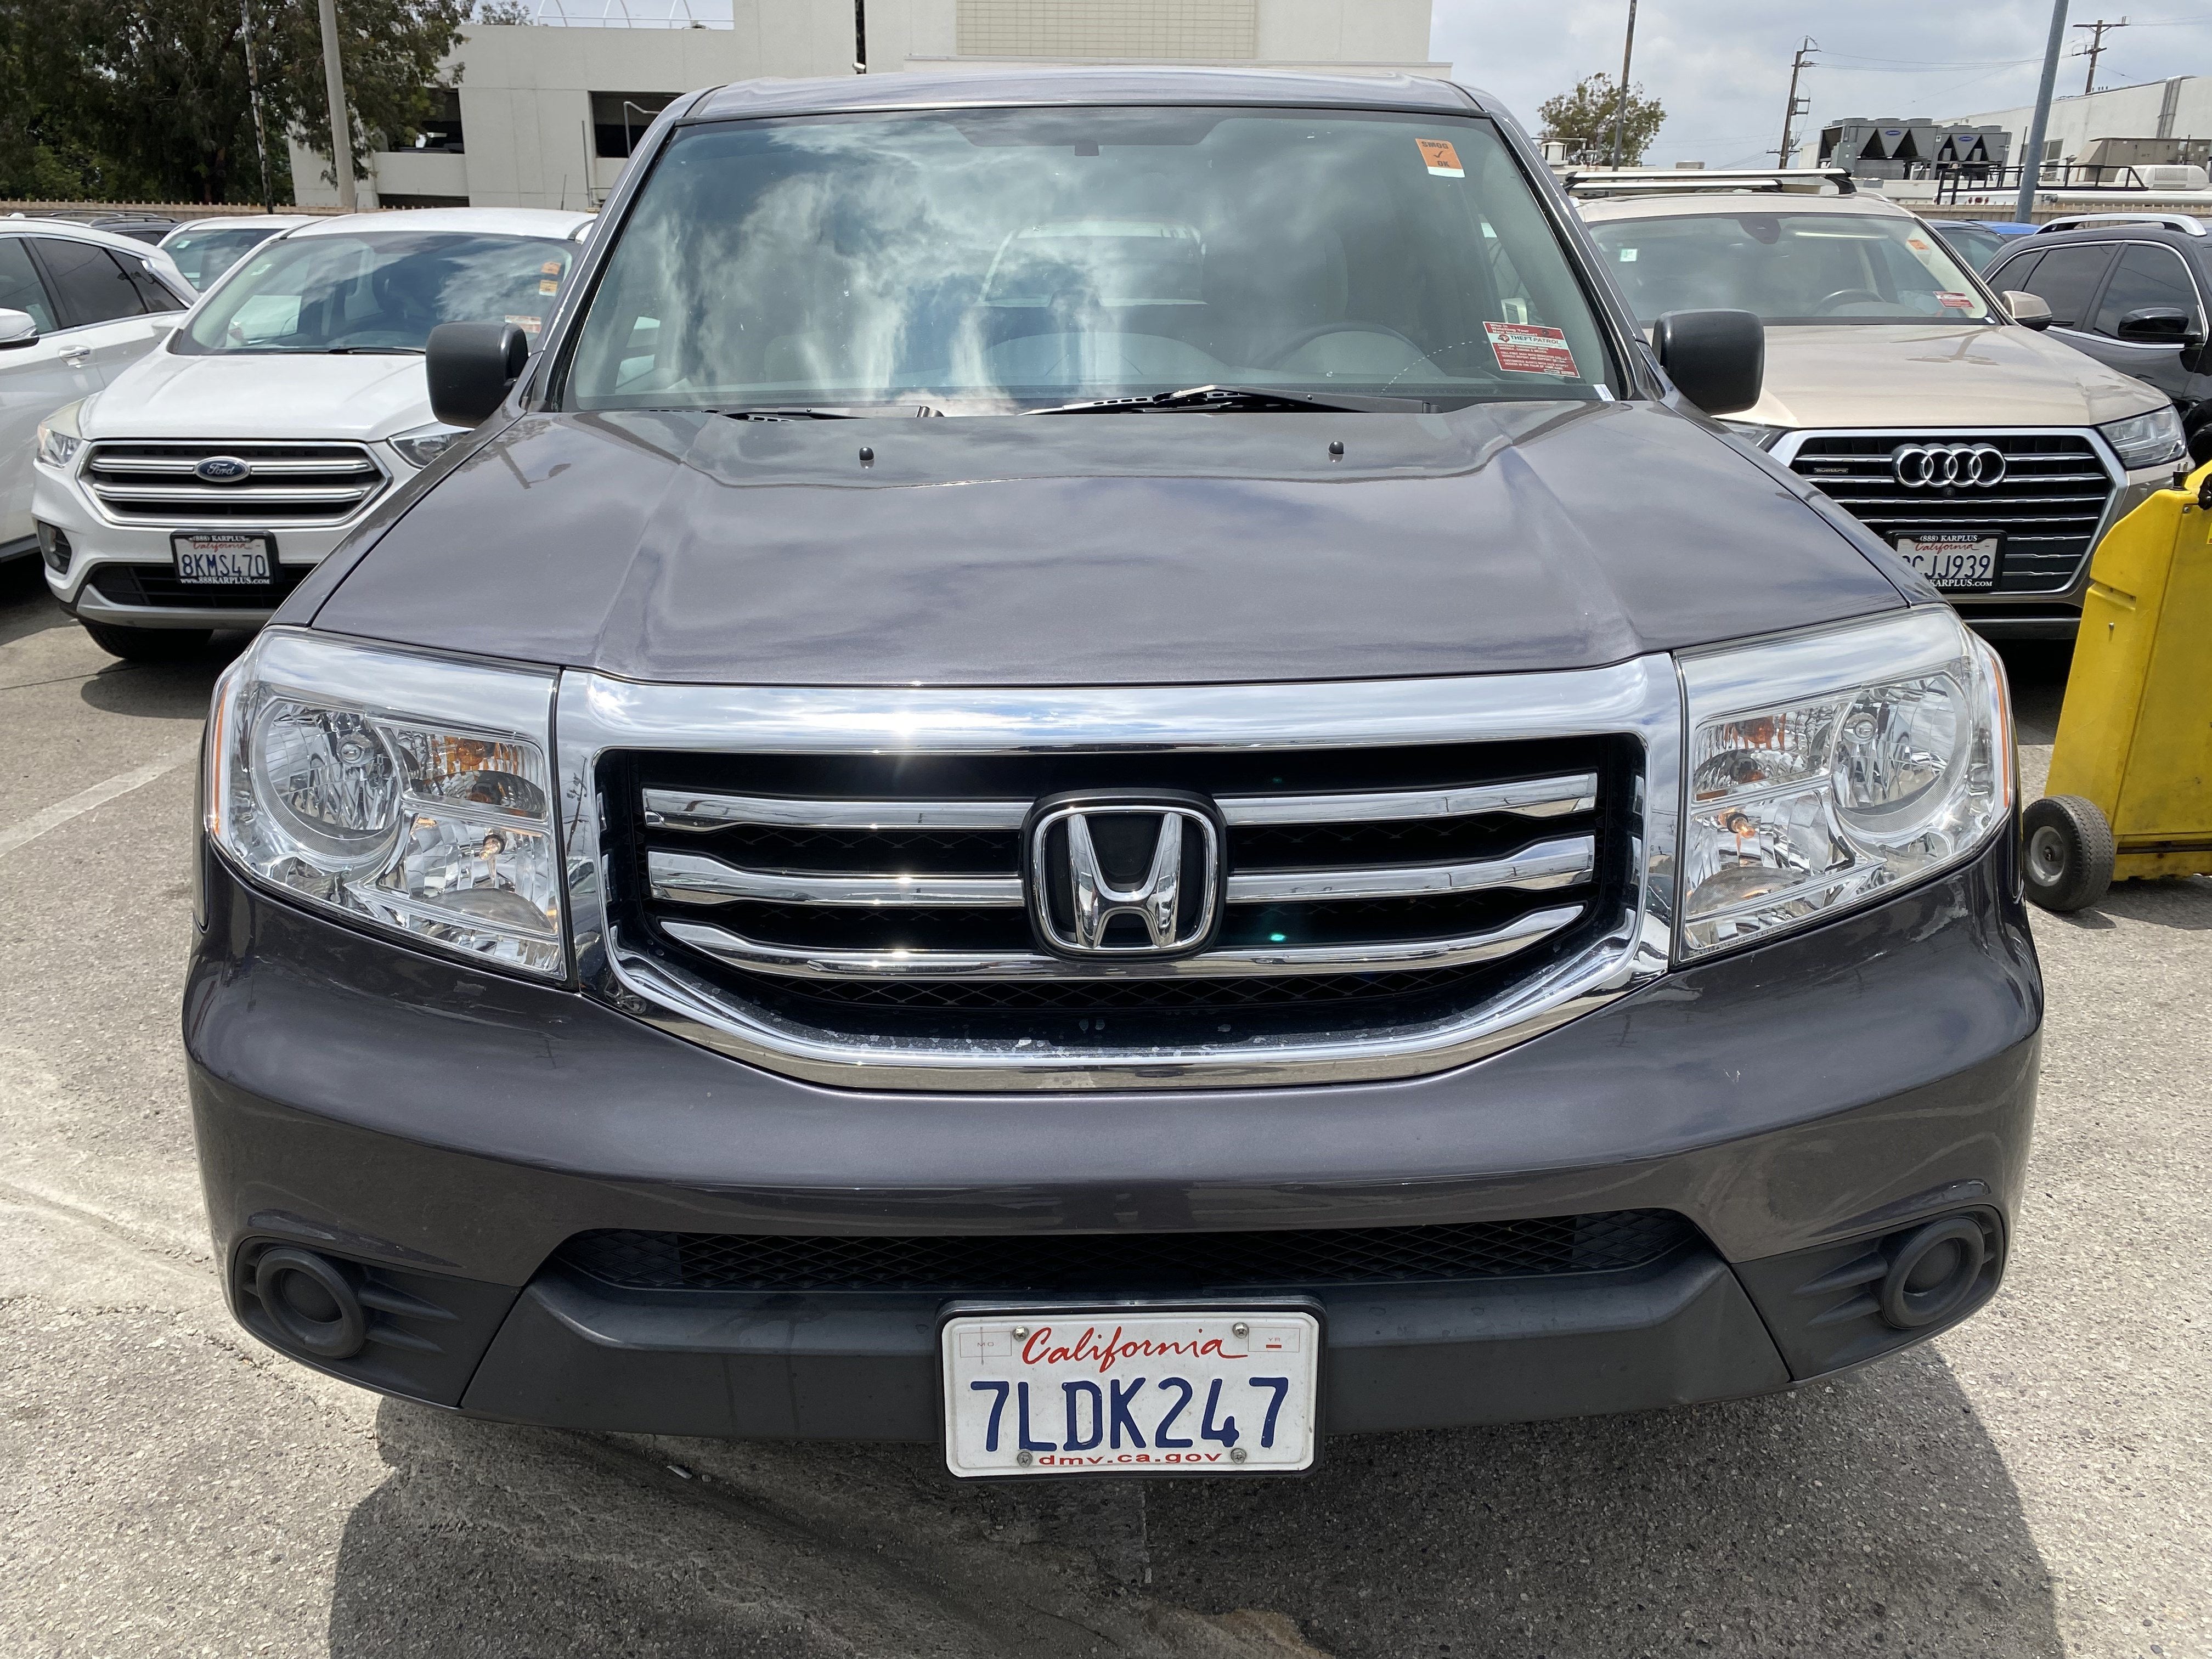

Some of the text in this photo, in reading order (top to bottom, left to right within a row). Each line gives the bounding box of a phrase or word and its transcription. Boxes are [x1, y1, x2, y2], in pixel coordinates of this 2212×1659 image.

[207, 462, 235, 475] Ford
[193, 541, 252, 552] California
[1915, 543, 1980, 555] California
[182, 554, 266, 576] 8KMS470
[1022, 1326, 1248, 1373] California
[970, 1376, 1289, 1452] 7LDK247
[1039, 1452, 1222, 1465] dmv.ca.gov
